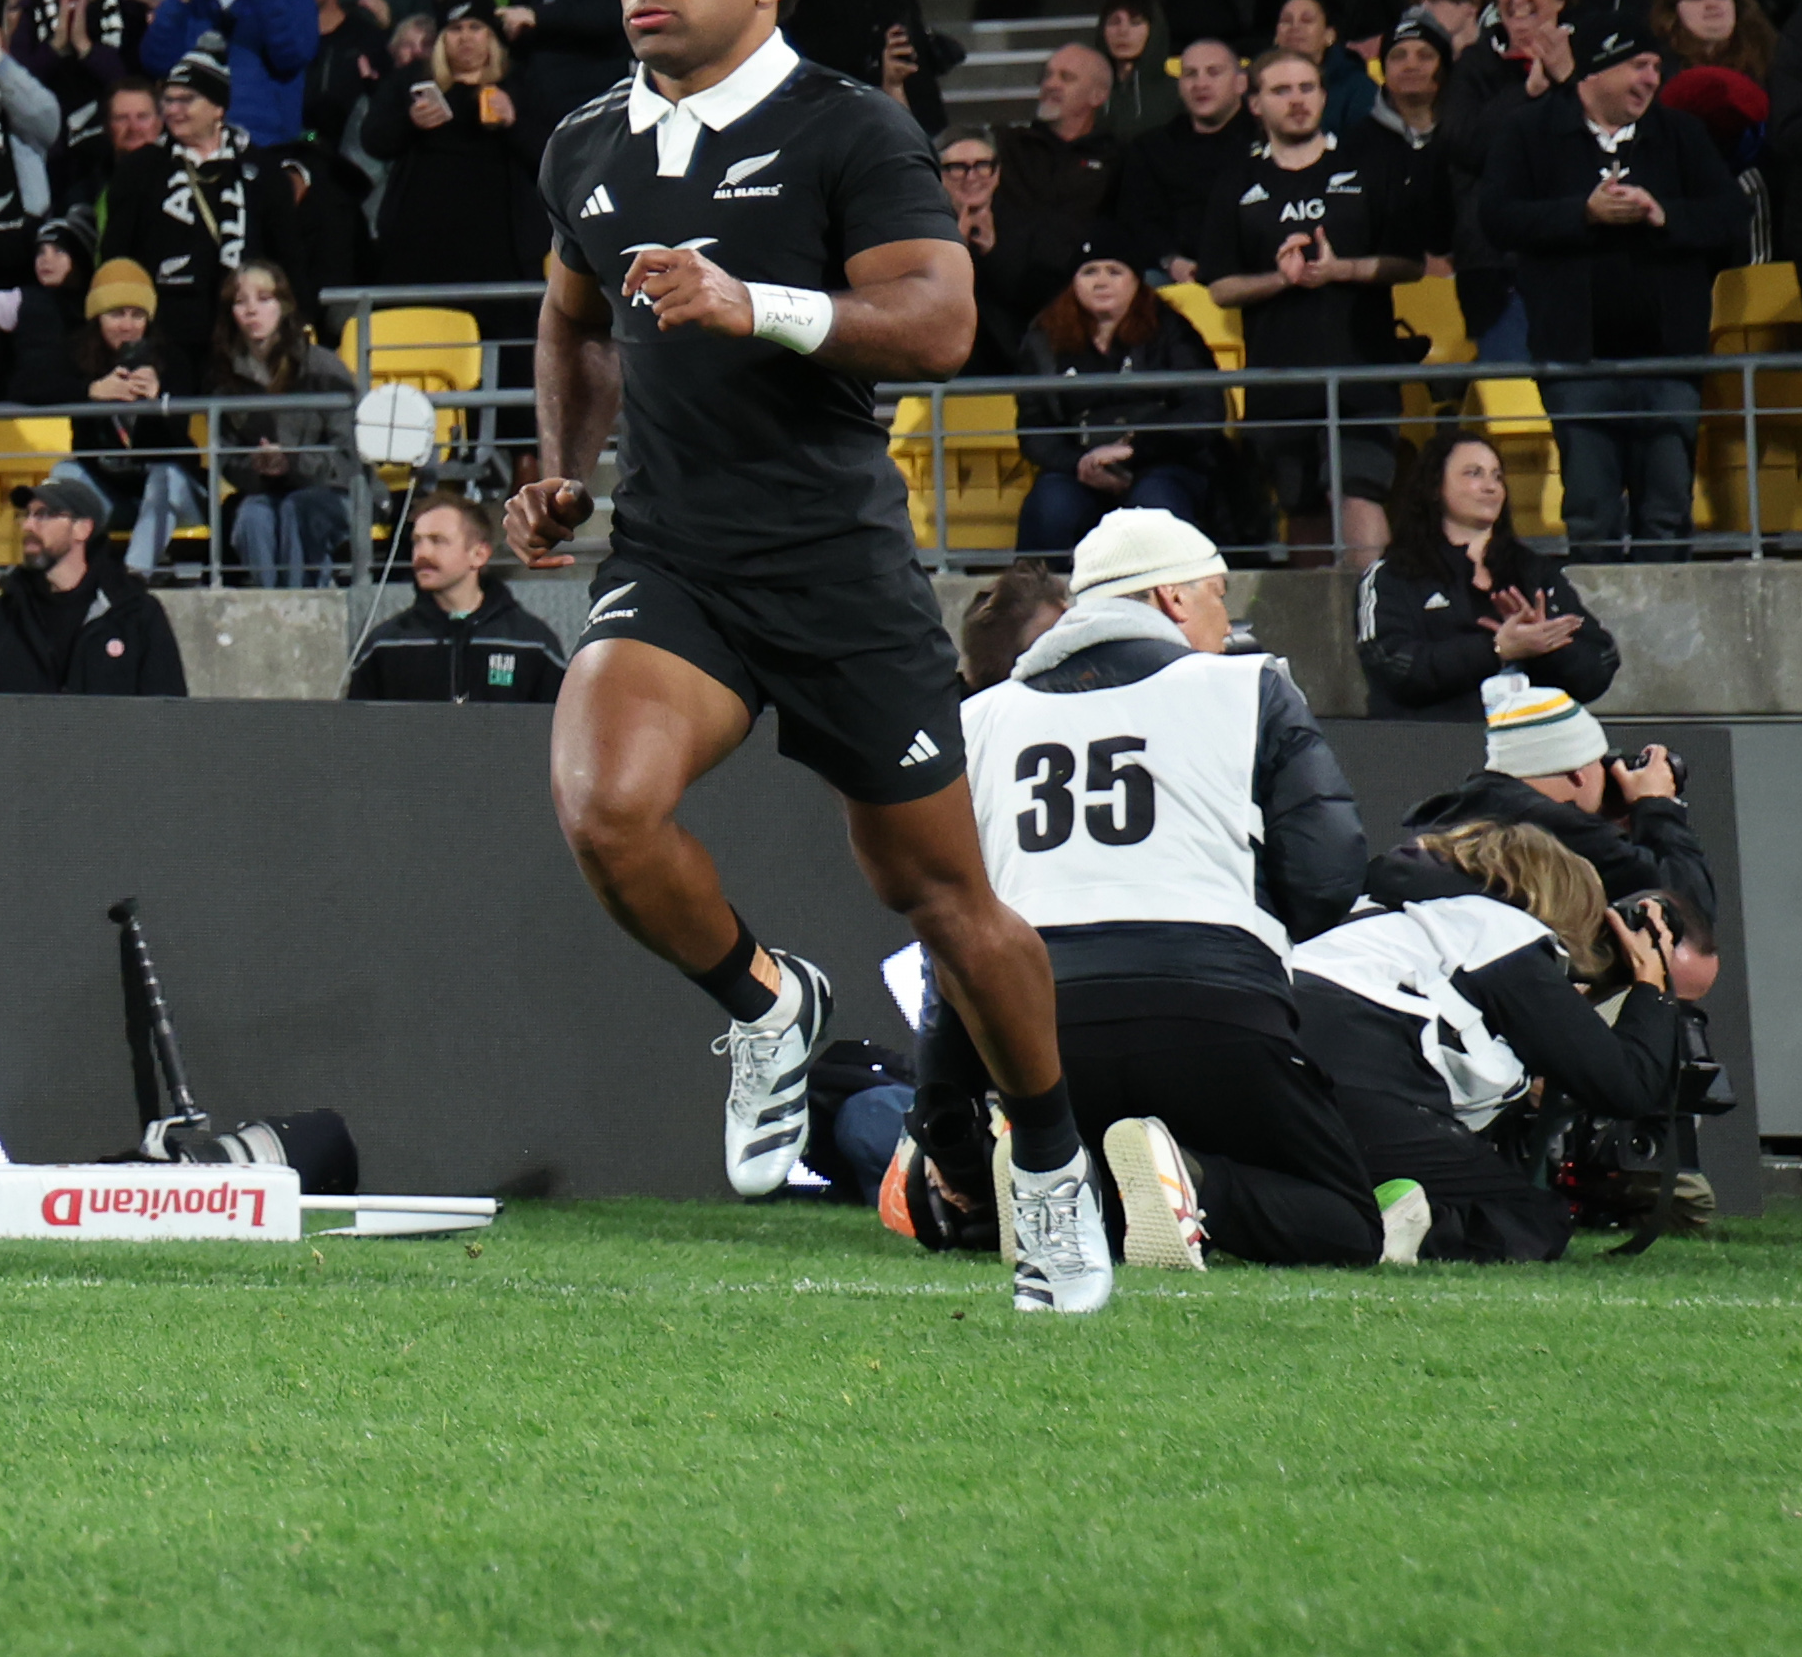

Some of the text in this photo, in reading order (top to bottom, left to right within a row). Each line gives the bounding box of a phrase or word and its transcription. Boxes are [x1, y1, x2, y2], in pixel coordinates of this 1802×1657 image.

[1279, 197, 1326, 223] AIG
[765, 311, 814, 327] FAMILY
[1015, 735, 1156, 852] 35
